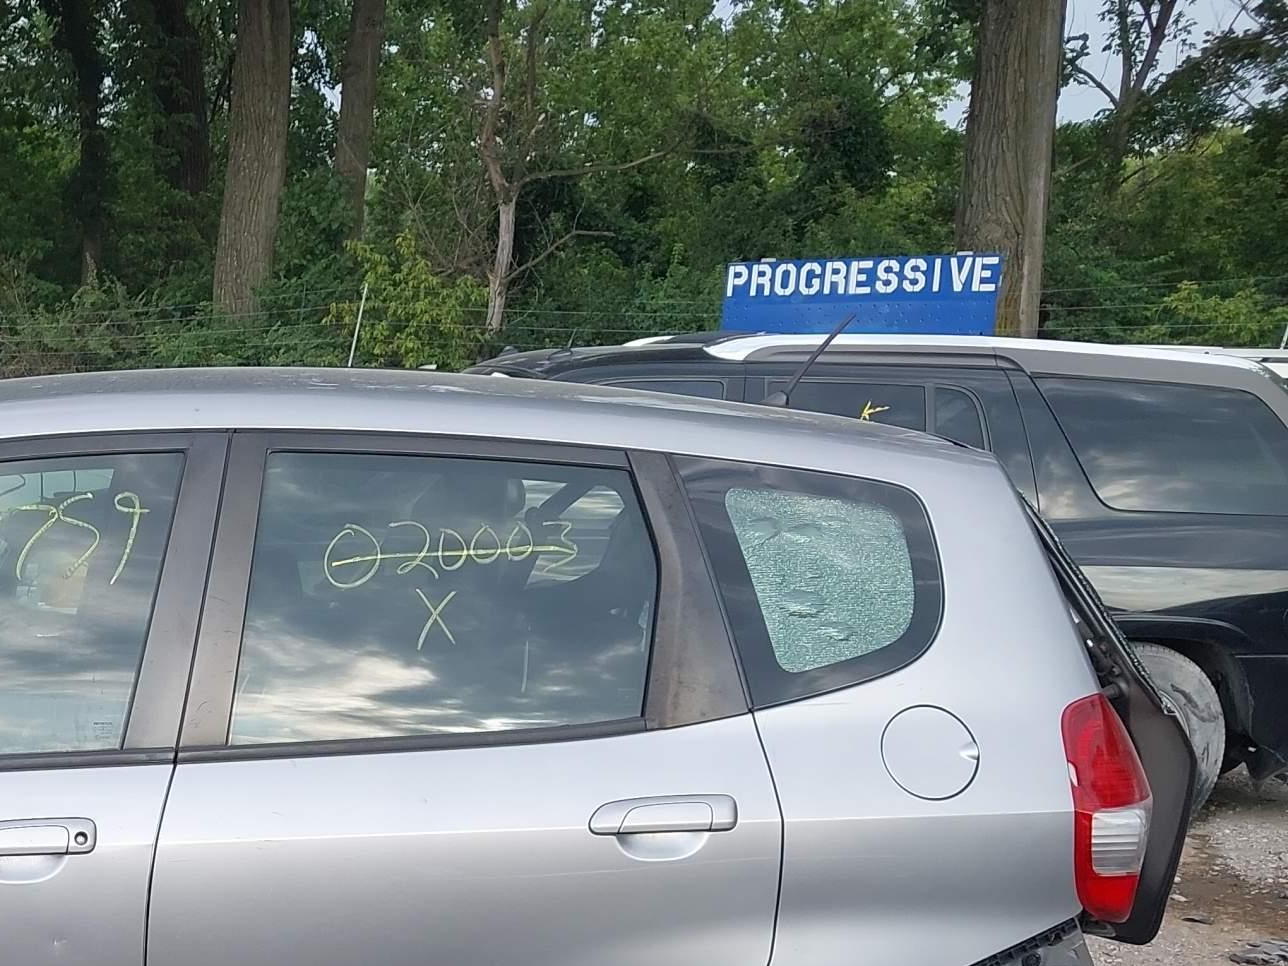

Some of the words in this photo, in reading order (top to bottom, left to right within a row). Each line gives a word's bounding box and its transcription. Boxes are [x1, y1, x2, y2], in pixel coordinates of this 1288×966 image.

[726, 256, 1000, 297] PROGRESSIVE
[324, 520, 579, 588] 020003
[415, 588, 457, 651] X
